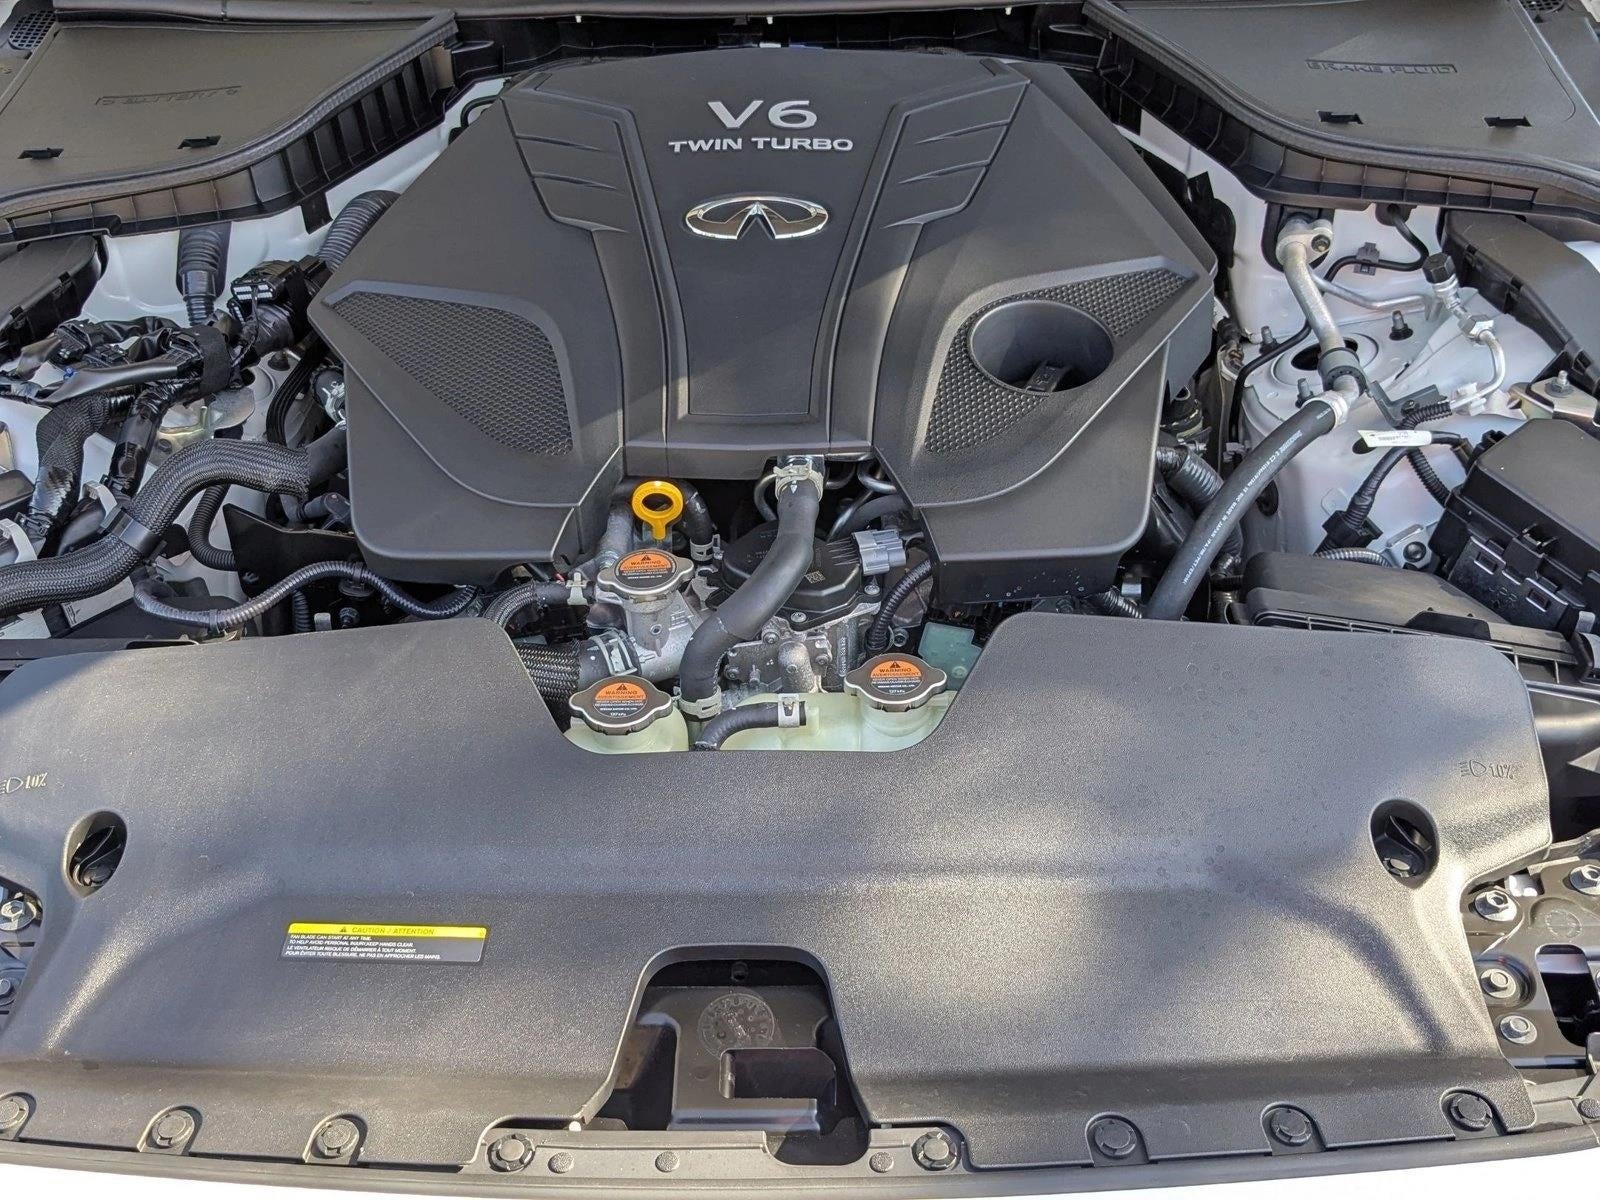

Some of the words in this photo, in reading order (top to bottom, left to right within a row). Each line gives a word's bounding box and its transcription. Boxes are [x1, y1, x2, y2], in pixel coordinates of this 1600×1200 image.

[1306, 61, 1384, 74] BRAKE
[708, 100, 818, 129] V6
[668, 138, 742, 153] TWIN
[751, 137, 854, 152] TURBO
